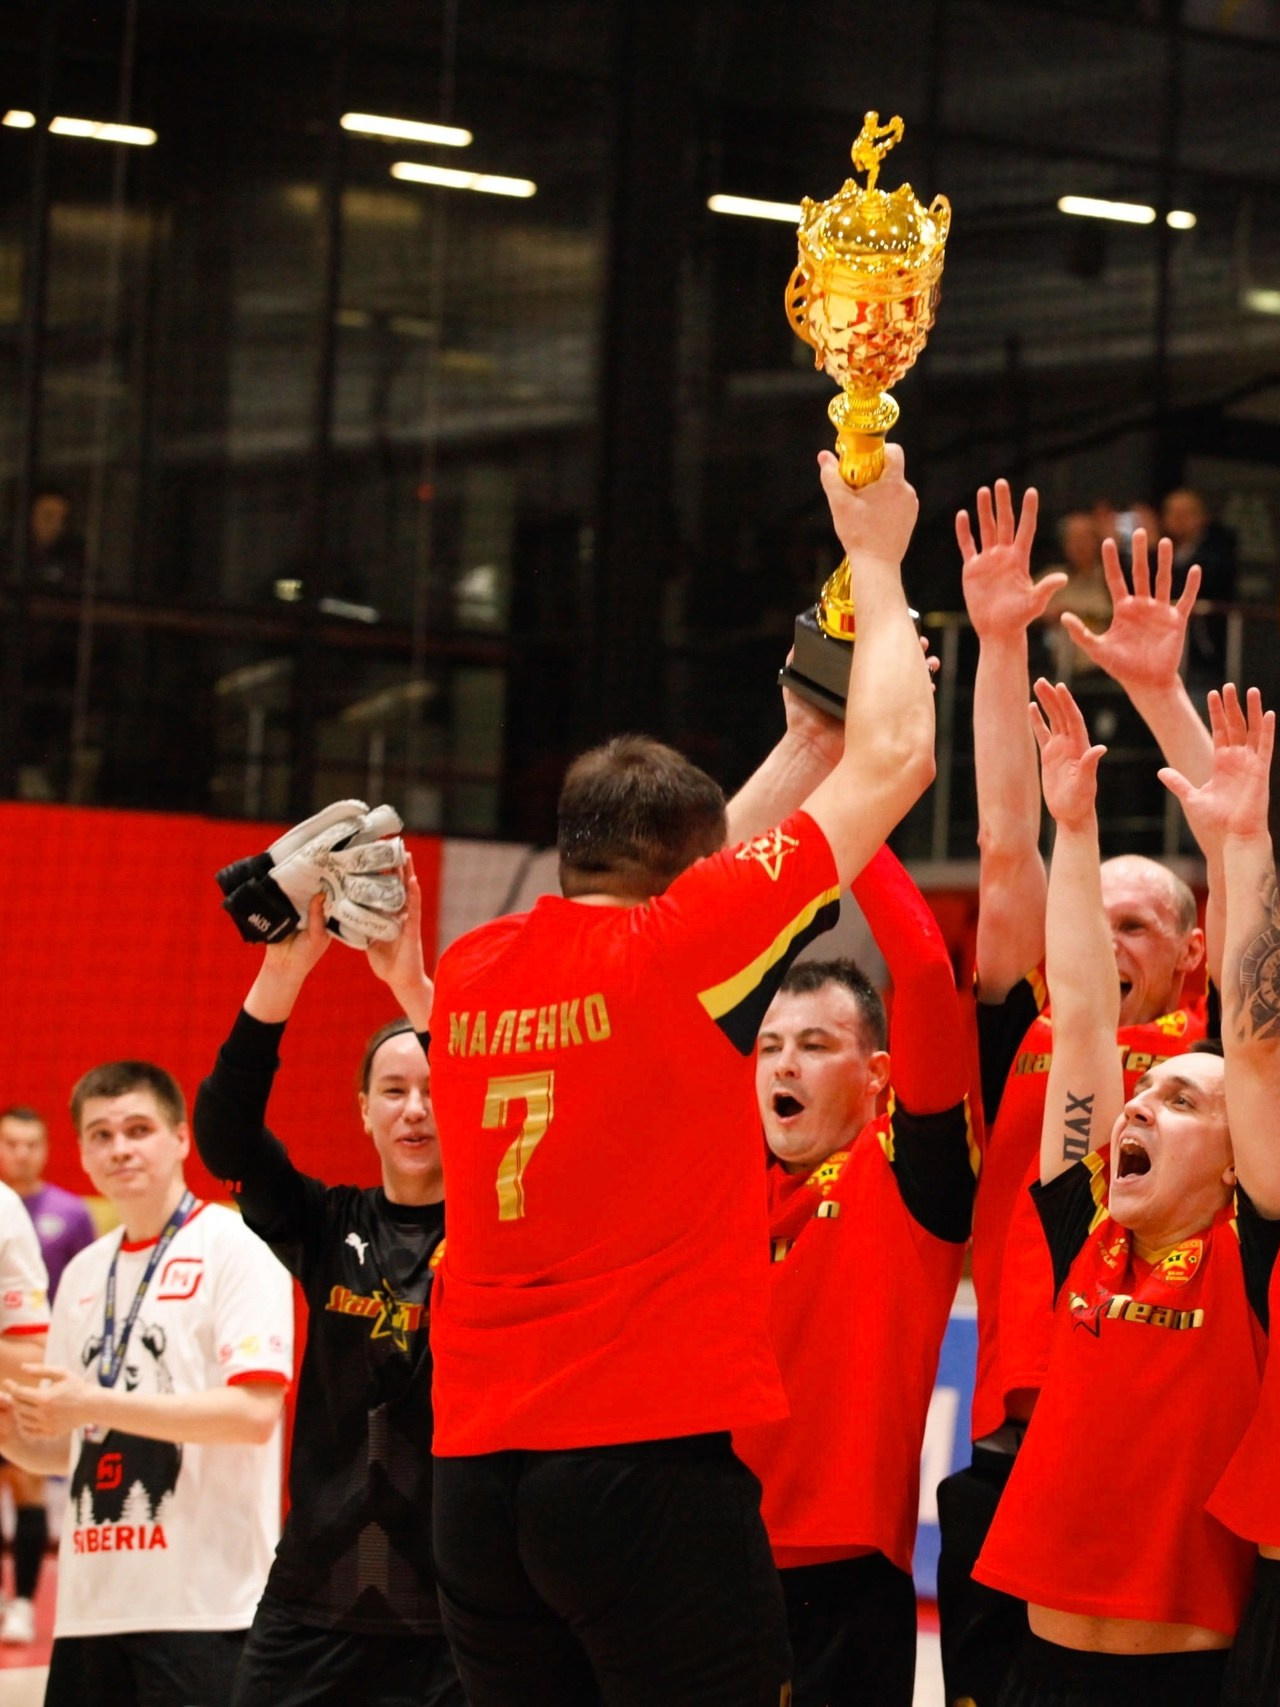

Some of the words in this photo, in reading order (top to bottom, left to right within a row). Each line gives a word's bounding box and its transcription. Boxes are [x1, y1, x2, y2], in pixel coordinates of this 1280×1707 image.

[448, 992, 611, 1057] МАЛЕНКО
[481, 1070, 555, 1221] 7
[1106, 1294, 1204, 1330] Team
